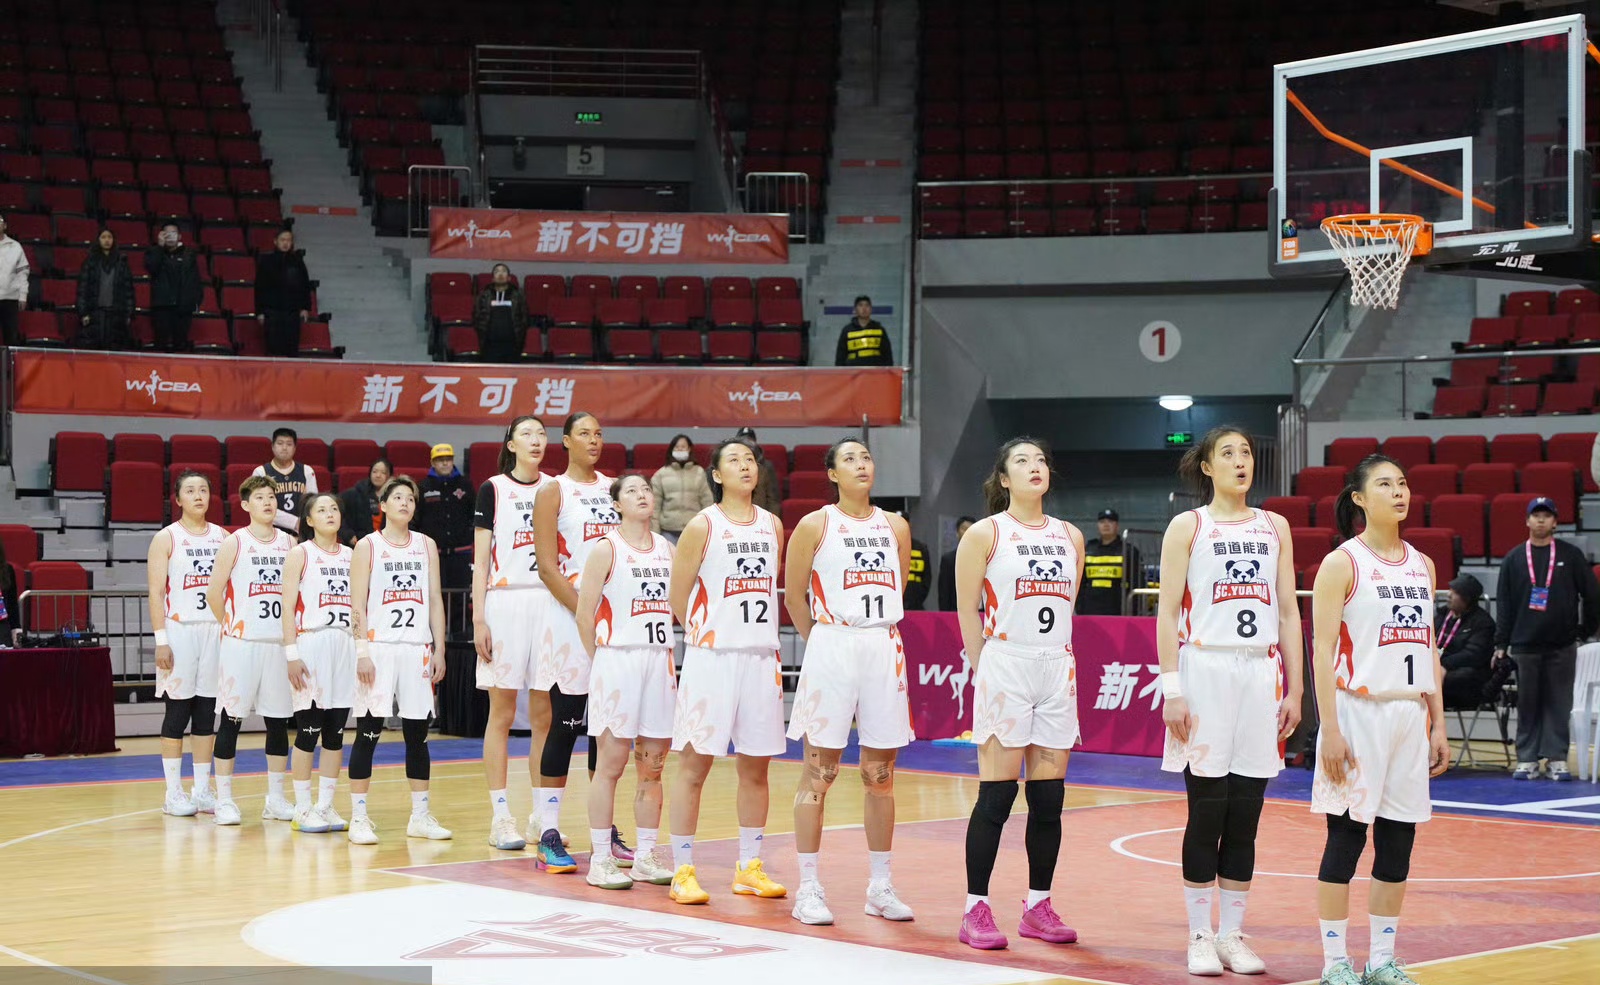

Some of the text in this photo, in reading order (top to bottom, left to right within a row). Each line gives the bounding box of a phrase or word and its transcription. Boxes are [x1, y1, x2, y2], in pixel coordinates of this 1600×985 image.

[579, 145, 592, 165] 5
[535, 219, 685, 255] 新不可挡
[1151, 326, 1166, 356] 1
[360, 374, 576, 416] 新不可挡
[283, 493, 295, 511] 3
[726, 541, 770, 554] 蜀道能源
[843, 536, 891, 548] 蜀道能源
[1016, 544, 1067, 556] 蜀道能源
[1212, 541, 1269, 556] 蜀道能源
[1376, 585, 1430, 601] 蜀道能源
[258, 600, 282, 619] 30
[739, 599, 768, 623] 12
[861, 594, 884, 618] 11
[390, 607, 415, 628] 22
[1037, 606, 1055, 634] 9
[1236, 609, 1258, 638] 8
[644, 621, 666, 644] 16
[1403, 654, 1414, 685] 1
